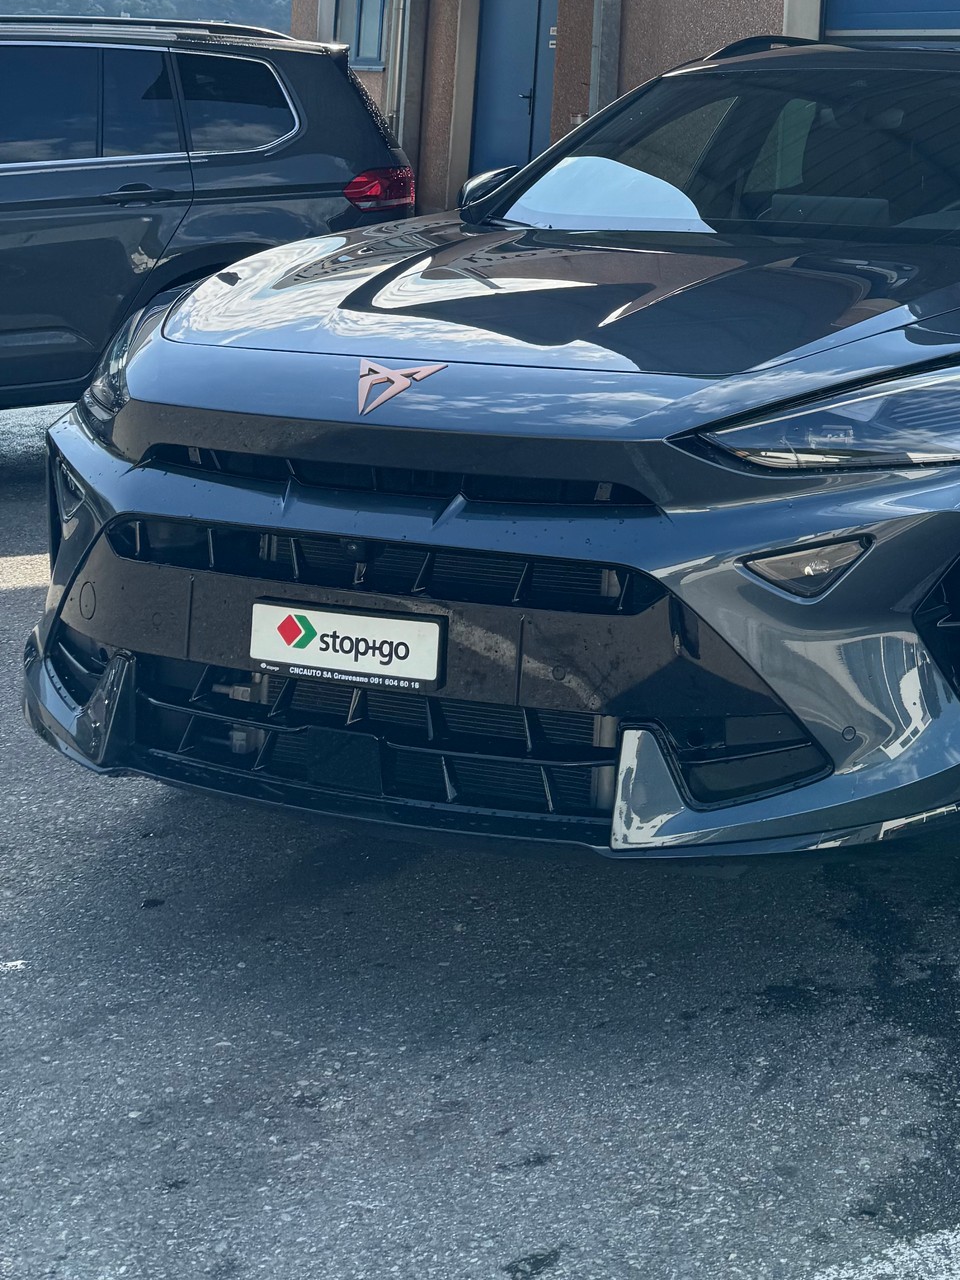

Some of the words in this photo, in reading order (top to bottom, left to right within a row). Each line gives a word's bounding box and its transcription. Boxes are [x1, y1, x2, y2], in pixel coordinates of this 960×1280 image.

[319, 630, 410, 666] stop+go
[289, 666, 321, 678] CNCAUTO
[322, 669, 332, 679] SA
